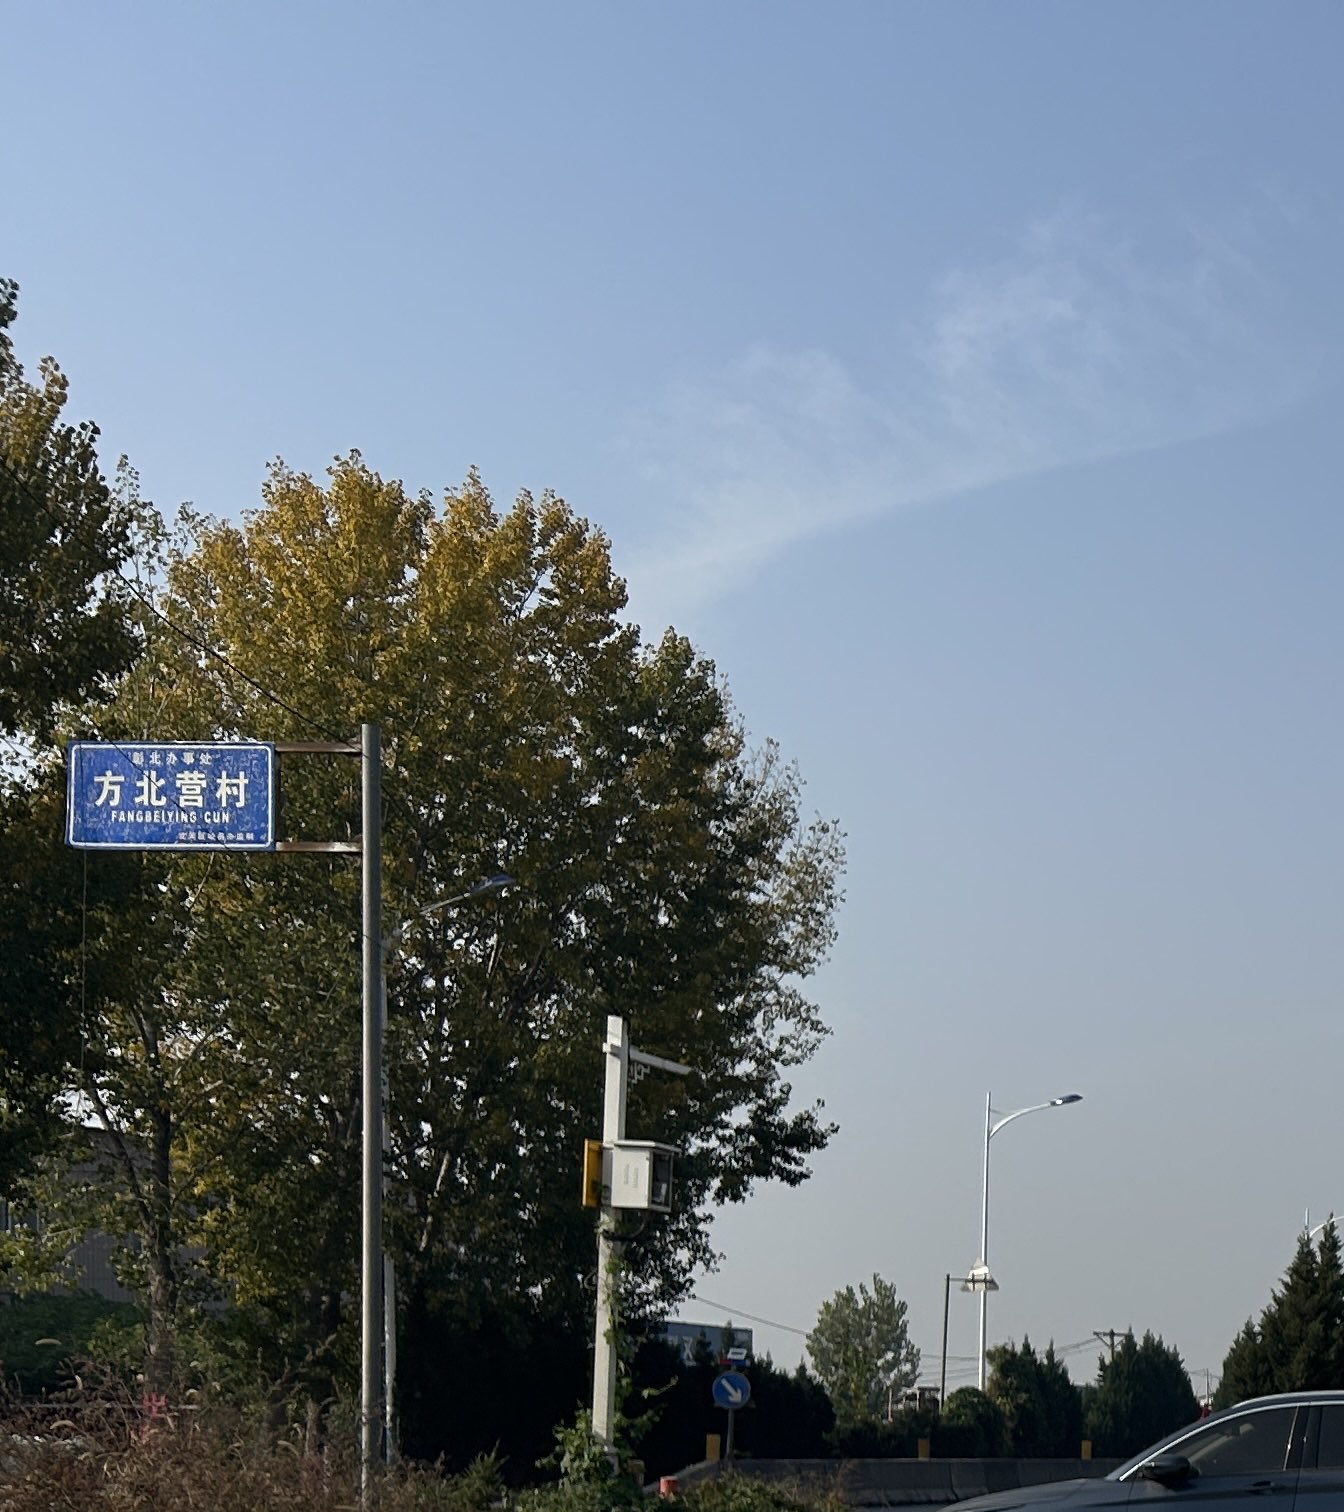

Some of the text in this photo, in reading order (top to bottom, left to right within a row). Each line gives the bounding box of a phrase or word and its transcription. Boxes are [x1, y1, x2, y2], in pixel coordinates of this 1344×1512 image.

[94, 770, 249, 809] 方北营村
[111, 810, 230, 823] FANGBEIYING CUN
